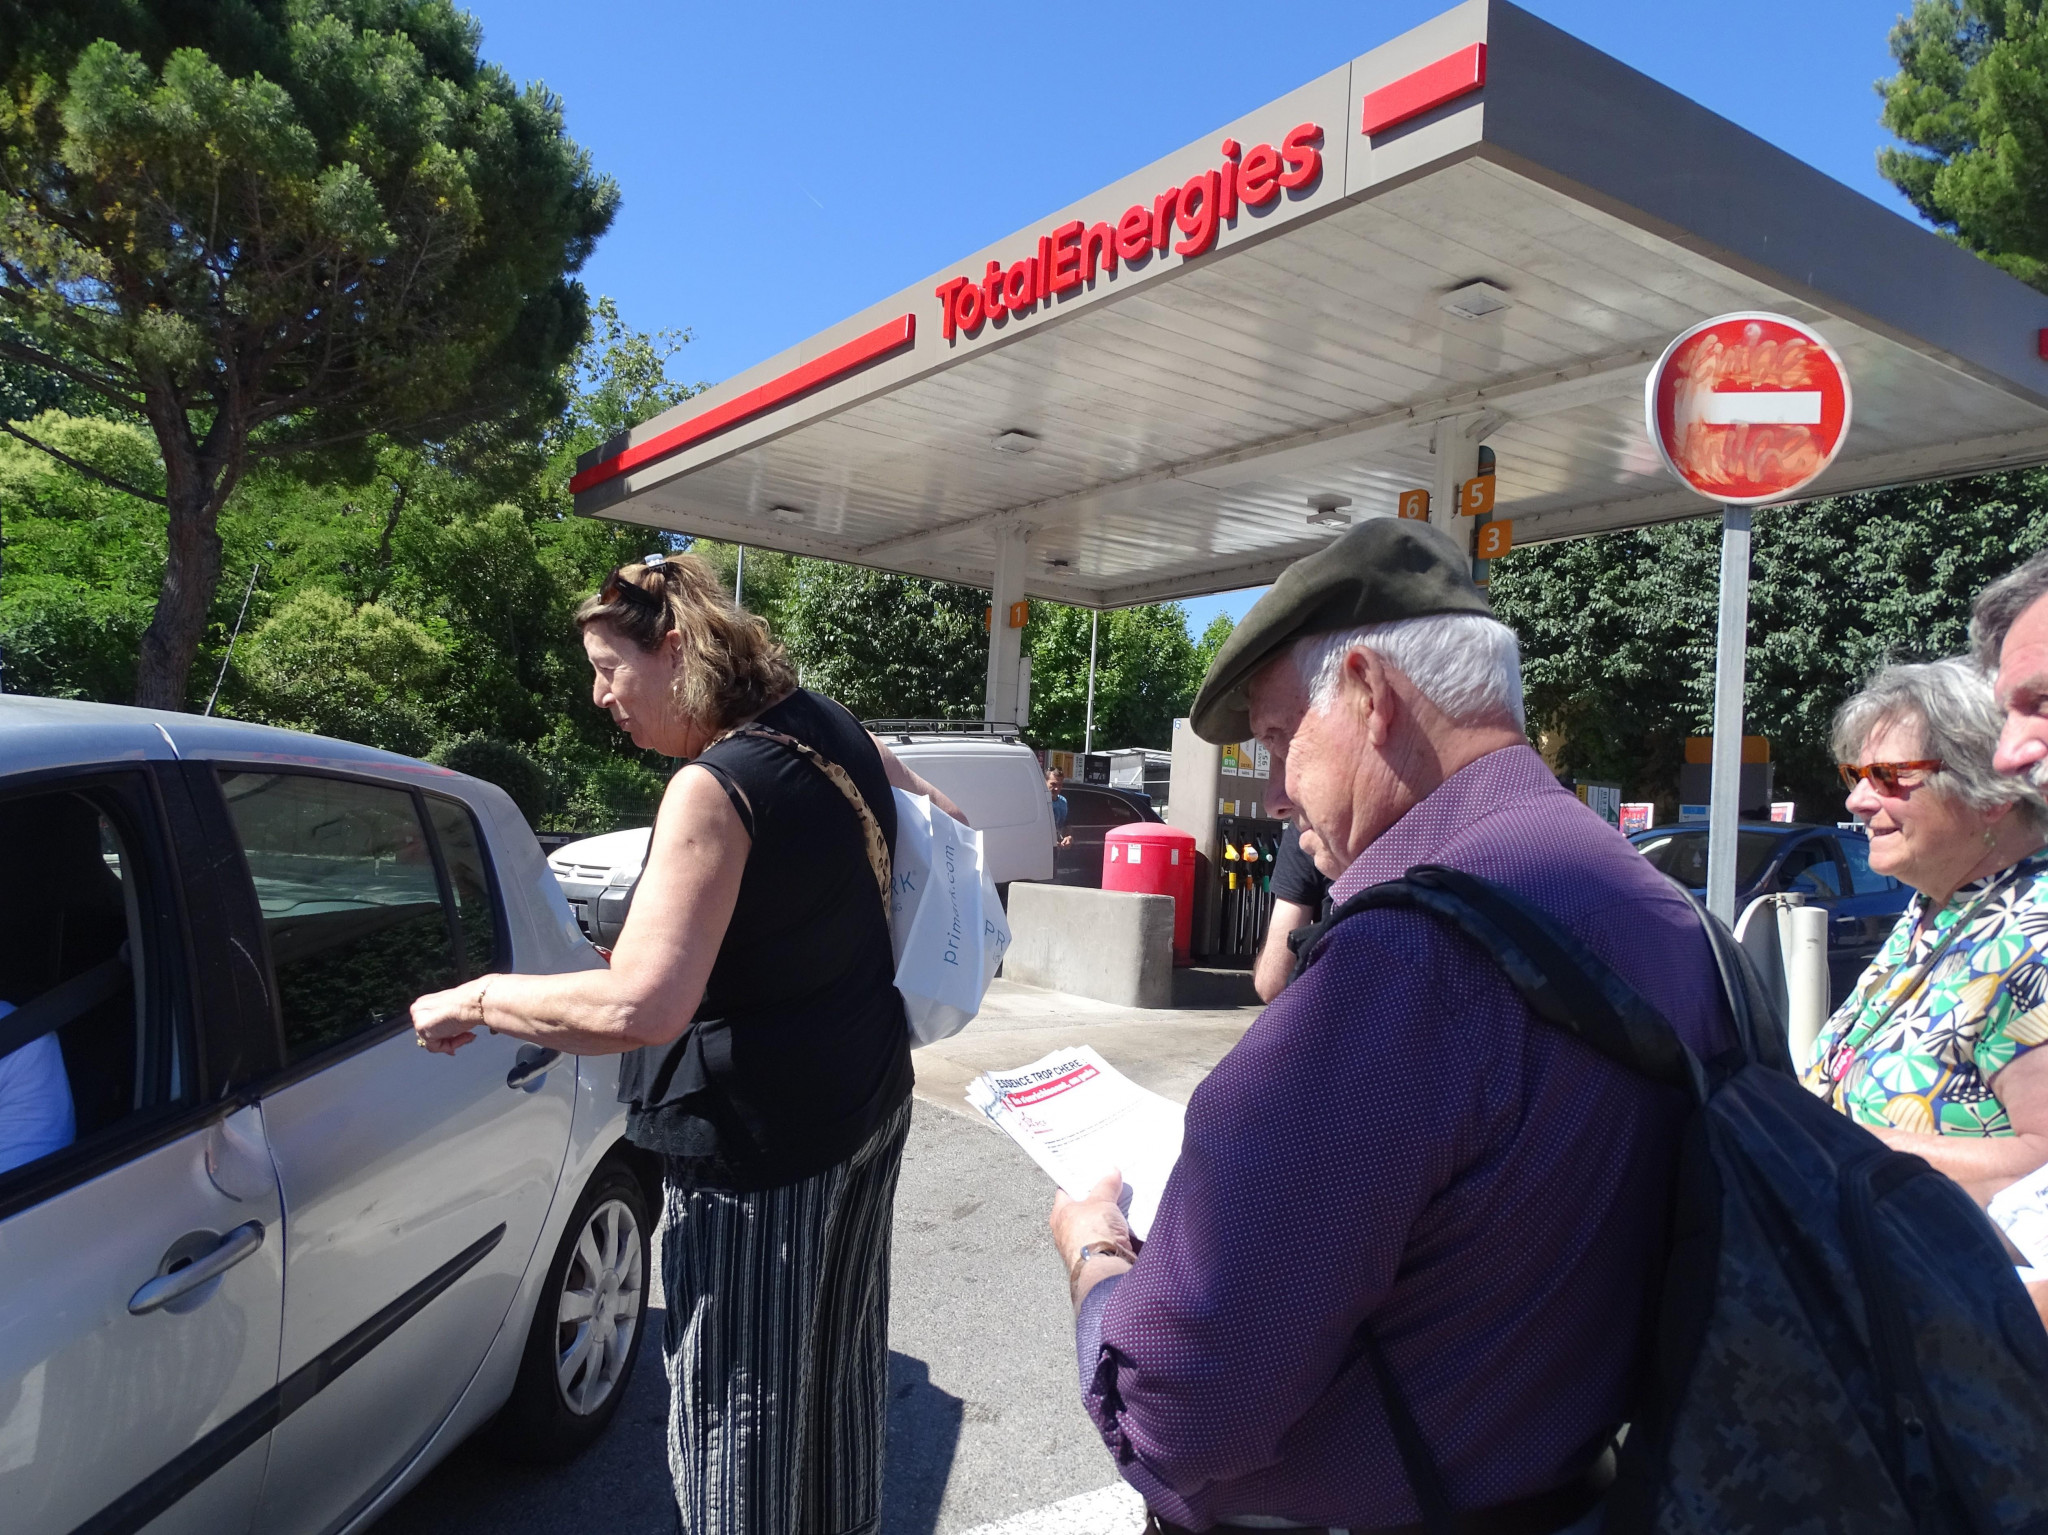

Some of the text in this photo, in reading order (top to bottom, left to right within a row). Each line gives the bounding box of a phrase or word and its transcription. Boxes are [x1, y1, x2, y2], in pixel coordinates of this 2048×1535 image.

[936, 121, 1324, 340] TotalEnergies
[1406, 495, 1419, 518] 6
[1470, 482, 1484, 508] 5
[1487, 527, 1500, 552] 3
[943, 845, 961, 966] primark.com
[995, 1074, 1034, 1089] ESSENCE
[1030, 1068, 1053, 1082] TROP
